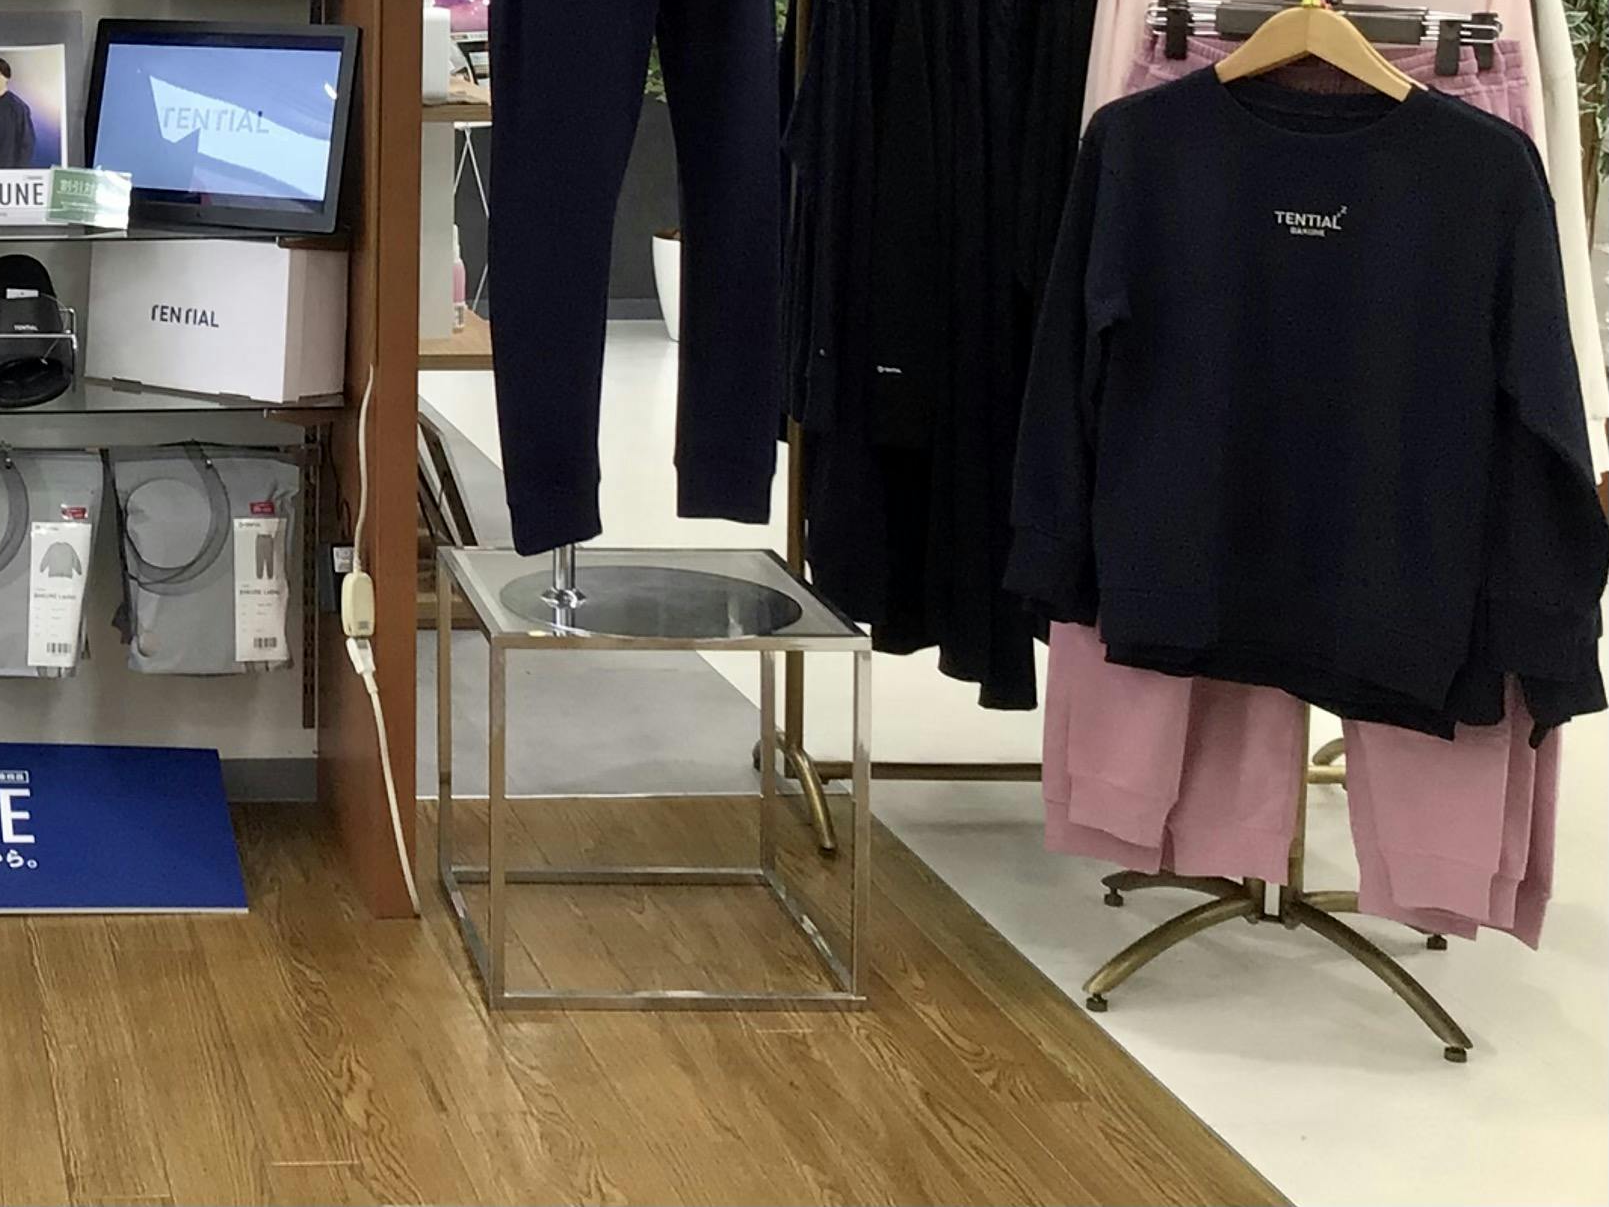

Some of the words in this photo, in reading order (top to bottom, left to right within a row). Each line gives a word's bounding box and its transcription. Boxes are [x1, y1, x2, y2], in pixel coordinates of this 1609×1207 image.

[159, 106, 269, 133] TENTIAL
[1274, 209, 1343, 230] TENTIAL
[150, 304, 220, 329] TENTIAL
